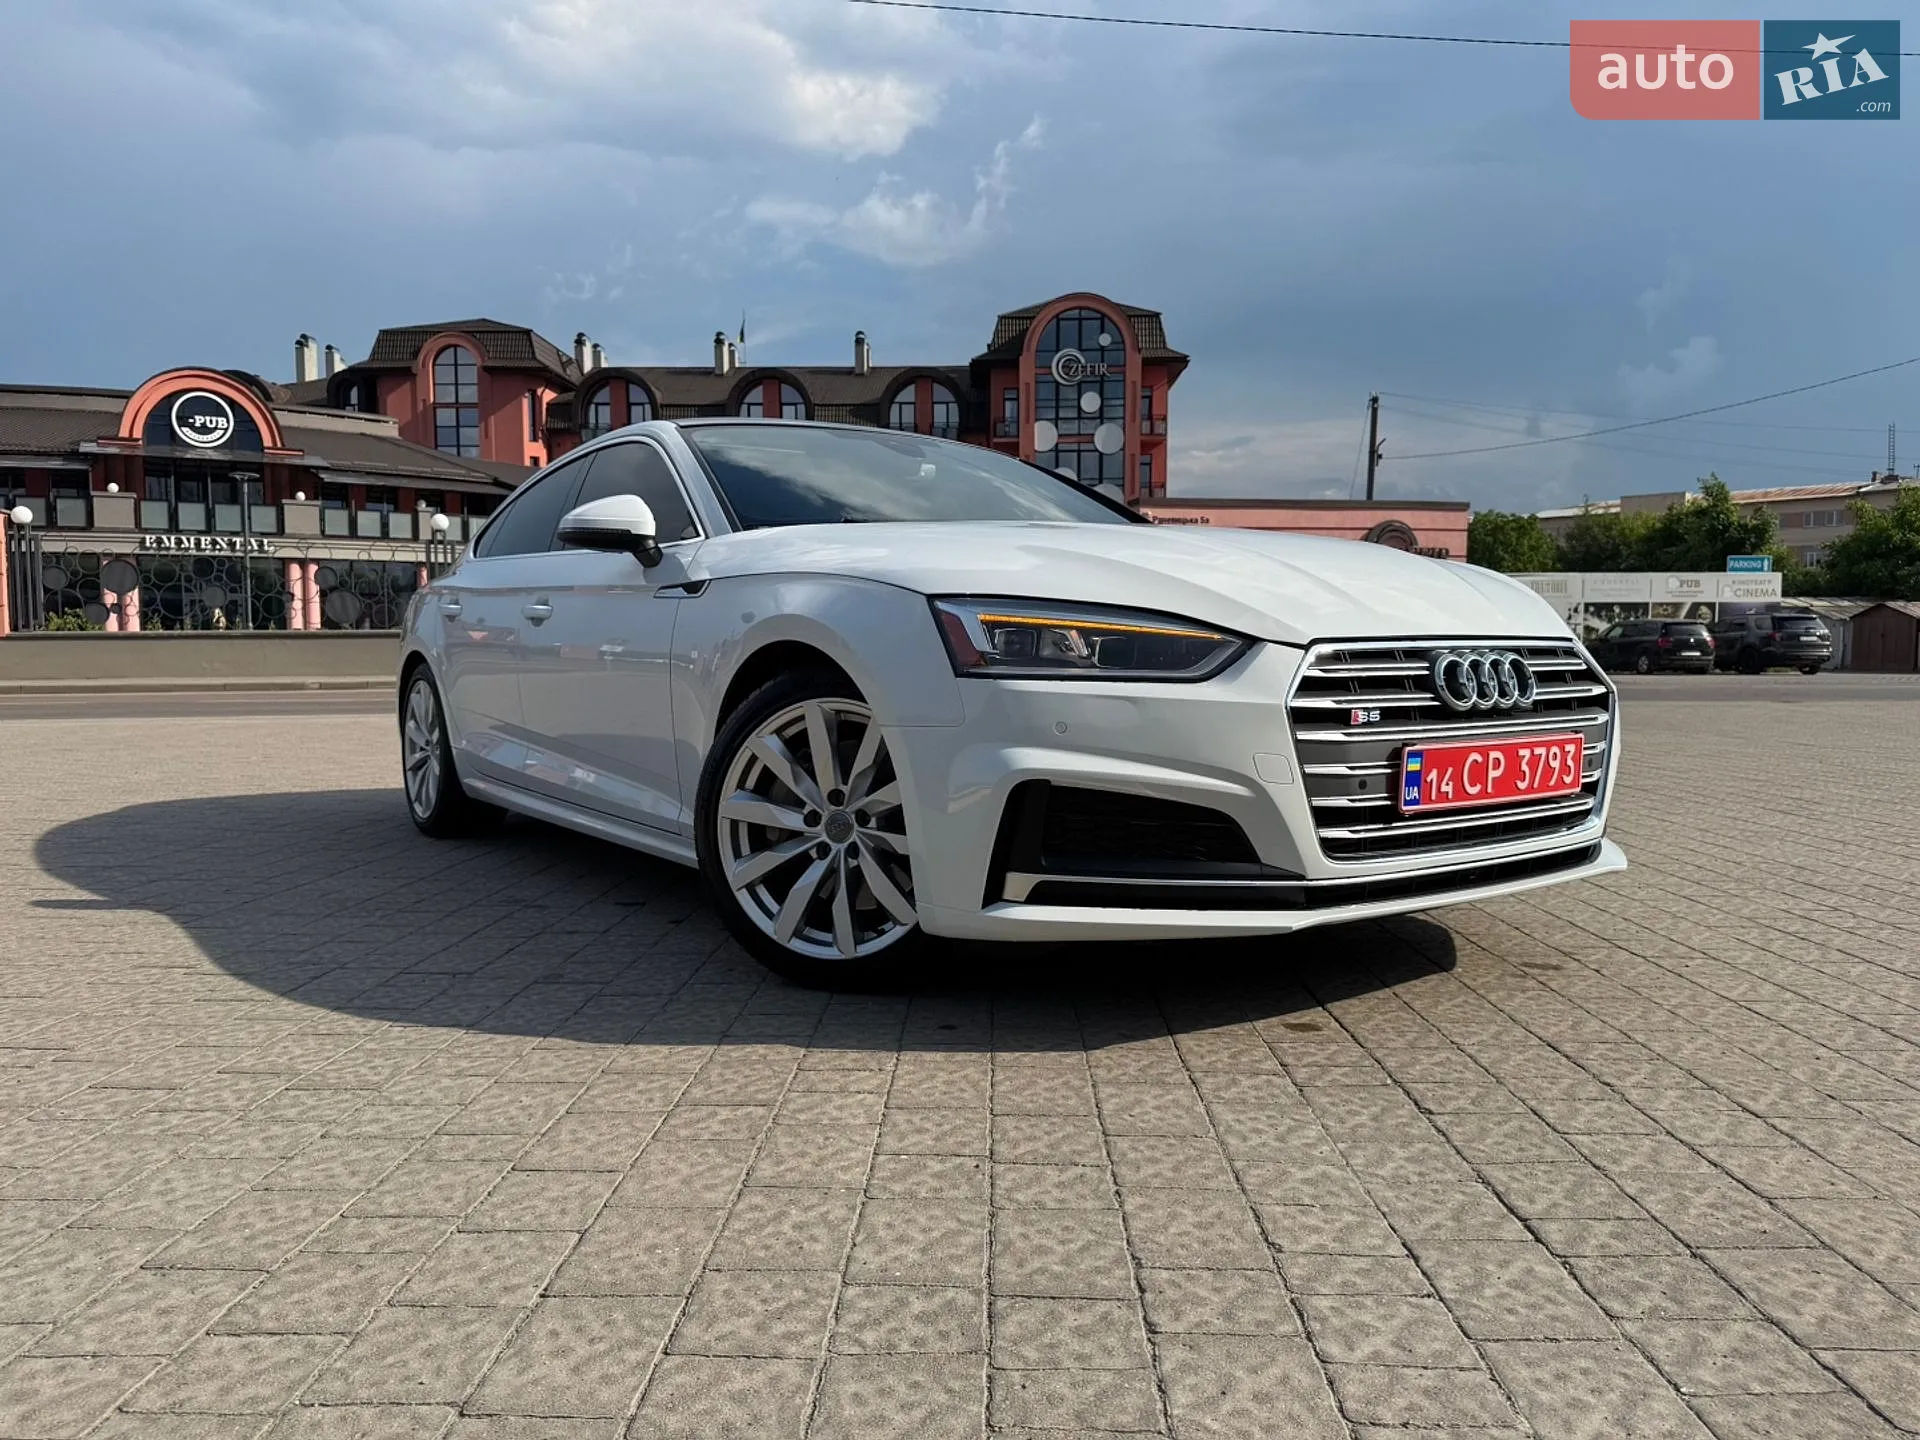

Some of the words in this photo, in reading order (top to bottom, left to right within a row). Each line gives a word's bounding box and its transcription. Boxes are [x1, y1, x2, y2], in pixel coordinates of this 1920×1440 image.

[144, 534, 276, 551] EMMENTAL
[1728, 559, 1762, 569] PARKING
[1679, 579, 1702, 589] PUB
[1733, 588, 1778, 599] CINEMA
[1426, 767, 1454, 801] 14
[1462, 750, 1506, 795] CP
[1514, 743, 1577, 791] 3793
[1405, 786, 1420, 801] UA
